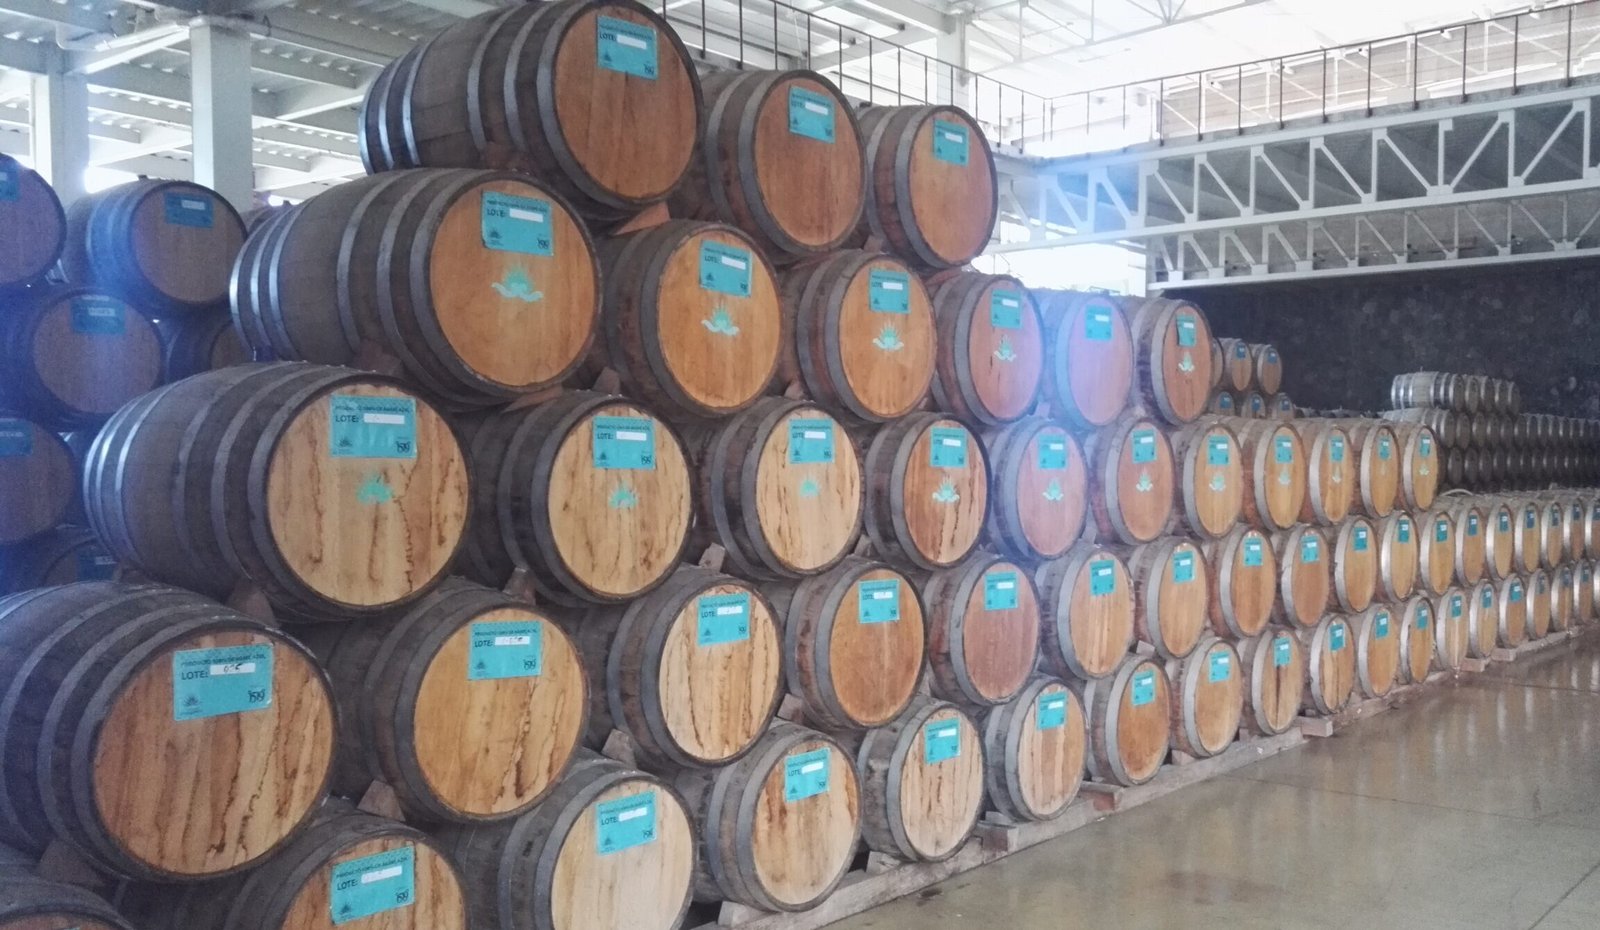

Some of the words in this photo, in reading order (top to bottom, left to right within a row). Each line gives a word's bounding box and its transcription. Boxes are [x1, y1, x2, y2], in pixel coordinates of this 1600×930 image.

[335, 415, 360, 423] LOTE:
[474, 640, 494, 648] LOTE:
[181, 670, 209, 680] LOTE:
[337, 878, 359, 891] LOTE:
